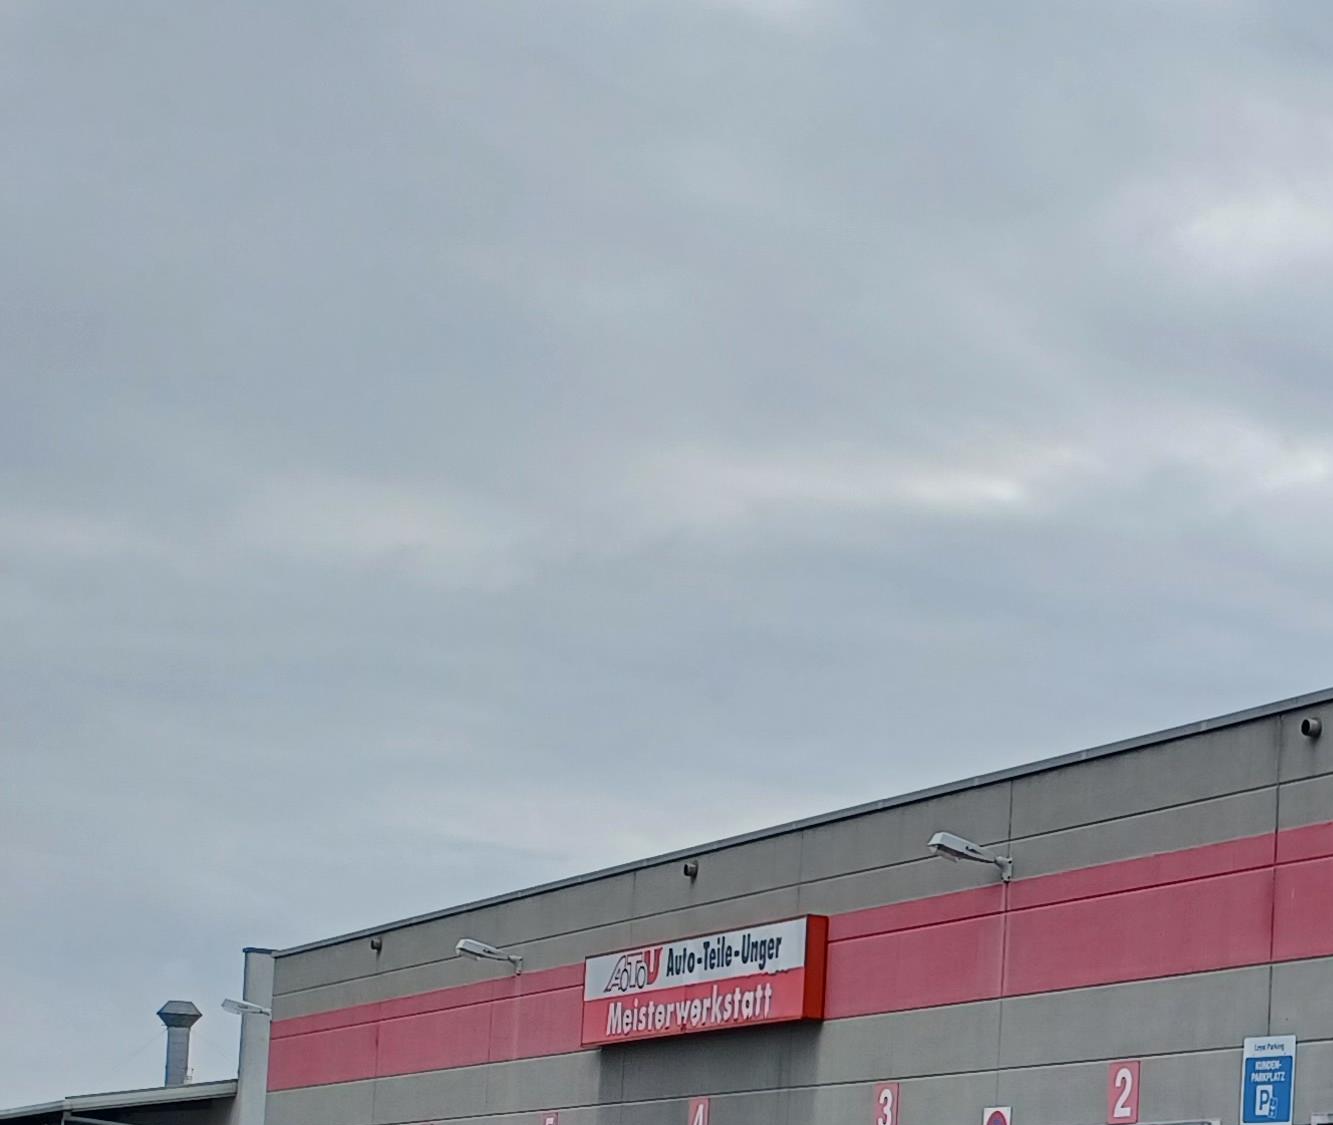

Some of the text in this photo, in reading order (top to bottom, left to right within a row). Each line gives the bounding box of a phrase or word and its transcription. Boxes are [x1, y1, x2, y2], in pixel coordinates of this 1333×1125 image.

[666, 933, 783, 978] Auto-Teile-Unger
[606, 983, 772, 1036] Meisterwerkstatt
[1114, 1067, 1133, 1118] 2
[1250, 1071, 1286, 1083] PARKPLATZ
